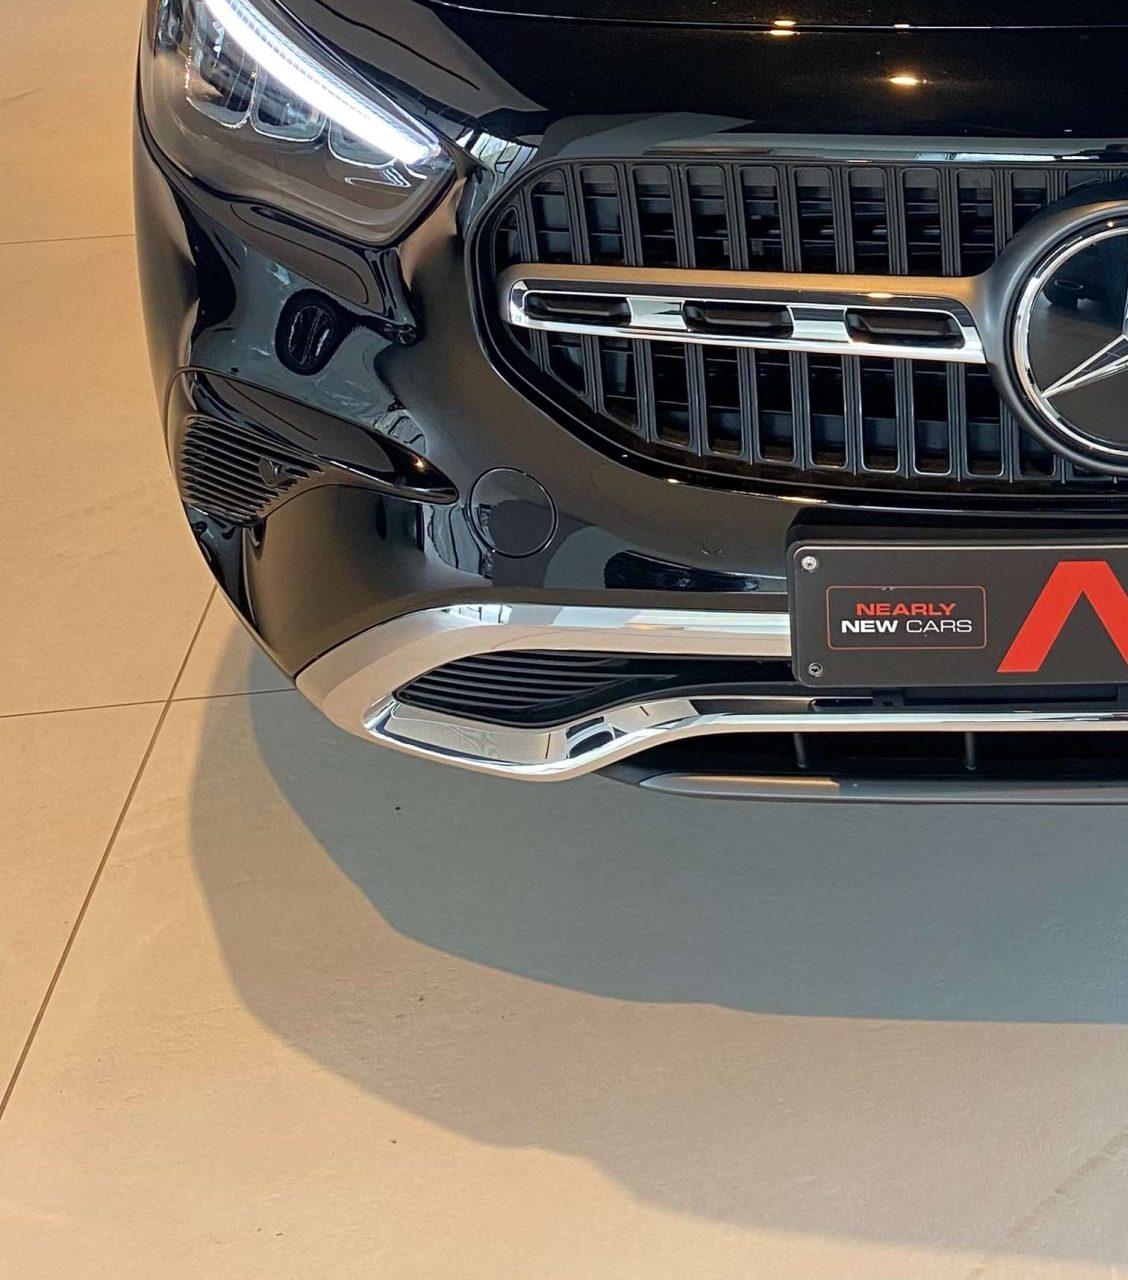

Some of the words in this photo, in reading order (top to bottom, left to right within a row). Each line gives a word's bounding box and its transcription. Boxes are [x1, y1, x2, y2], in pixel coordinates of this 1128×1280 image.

[857, 603, 955, 616] NEARLY
[842, 620, 898, 633] NEW
[907, 620, 972, 633] CARS
